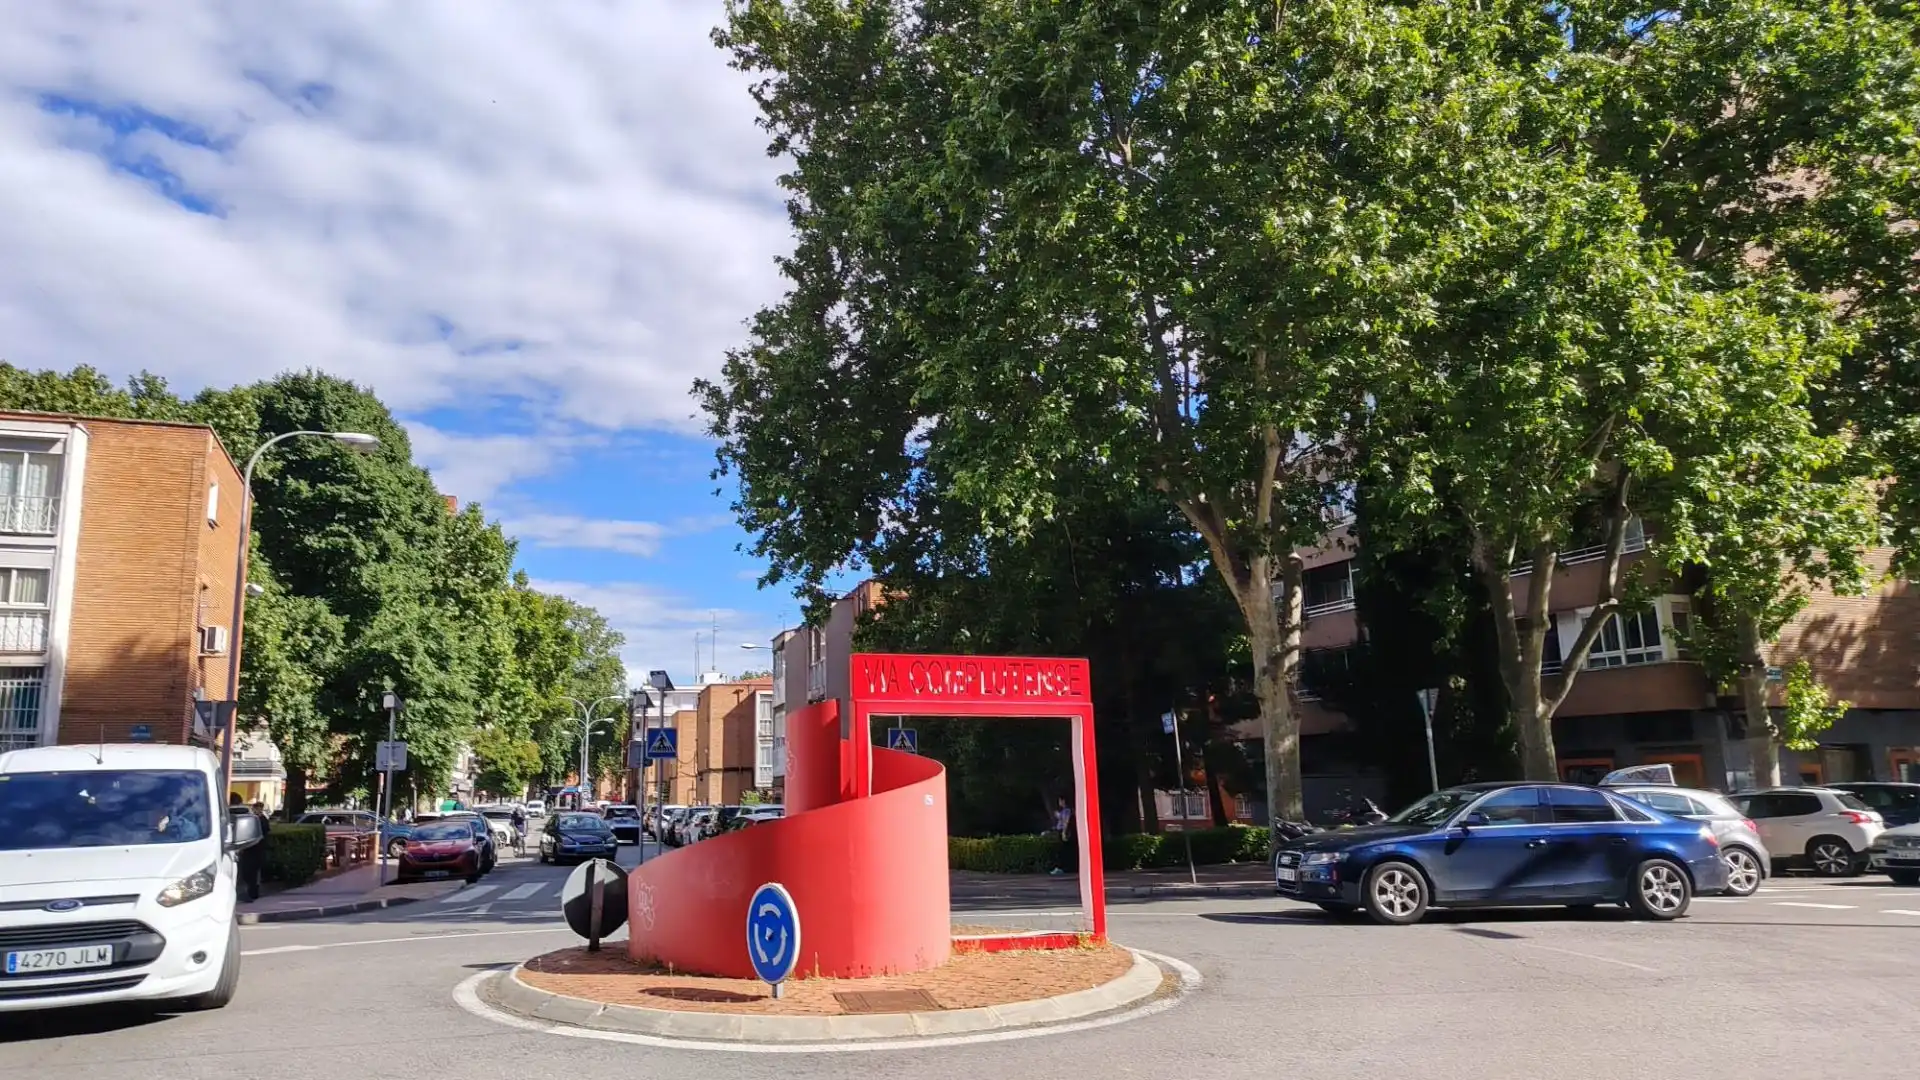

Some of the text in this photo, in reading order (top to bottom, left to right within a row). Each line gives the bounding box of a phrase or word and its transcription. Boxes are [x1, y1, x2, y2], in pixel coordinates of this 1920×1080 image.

[864, 658, 1082, 697] VIA COMPLUTENSE
[20, 947, 108, 969] 4270 JLM
